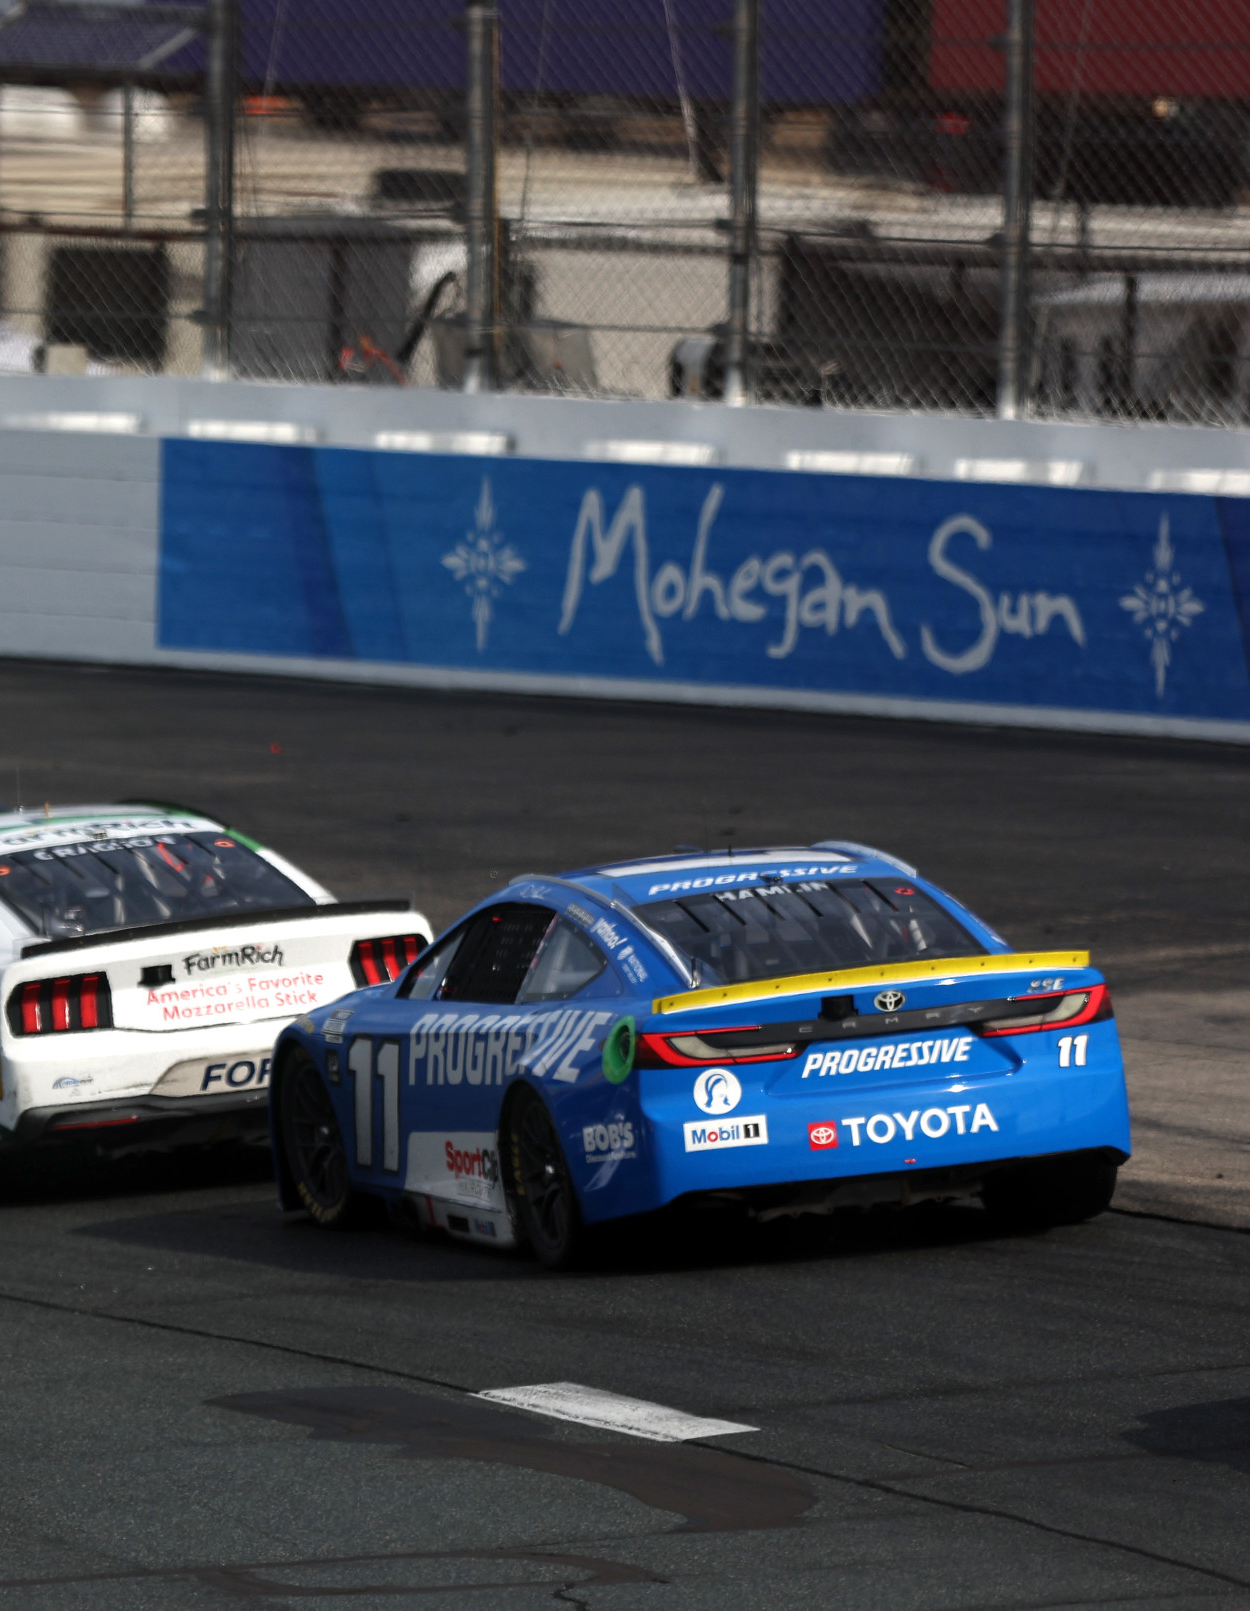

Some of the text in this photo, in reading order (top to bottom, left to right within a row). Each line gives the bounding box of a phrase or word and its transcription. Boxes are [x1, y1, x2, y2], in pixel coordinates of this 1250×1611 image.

[558, 483, 1086, 675] Mohegan Sun
[182, 944, 284, 975] FarmRich
[147, 972, 325, 1006] America's Favorite
[162, 990, 318, 1021] Mozzarella Stick
[799, 1006, 983, 1033] CAMRY
[801, 1036, 975, 1078] PROGRESSIVE
[1057, 1034, 1089, 1068] 11
[348, 1034, 400, 1174] 11
[583, 1122, 634, 1152] BOB'S
[691, 1124, 758, 1145] Mobil 1
[842, 1103, 999, 1146] TOYOTA
